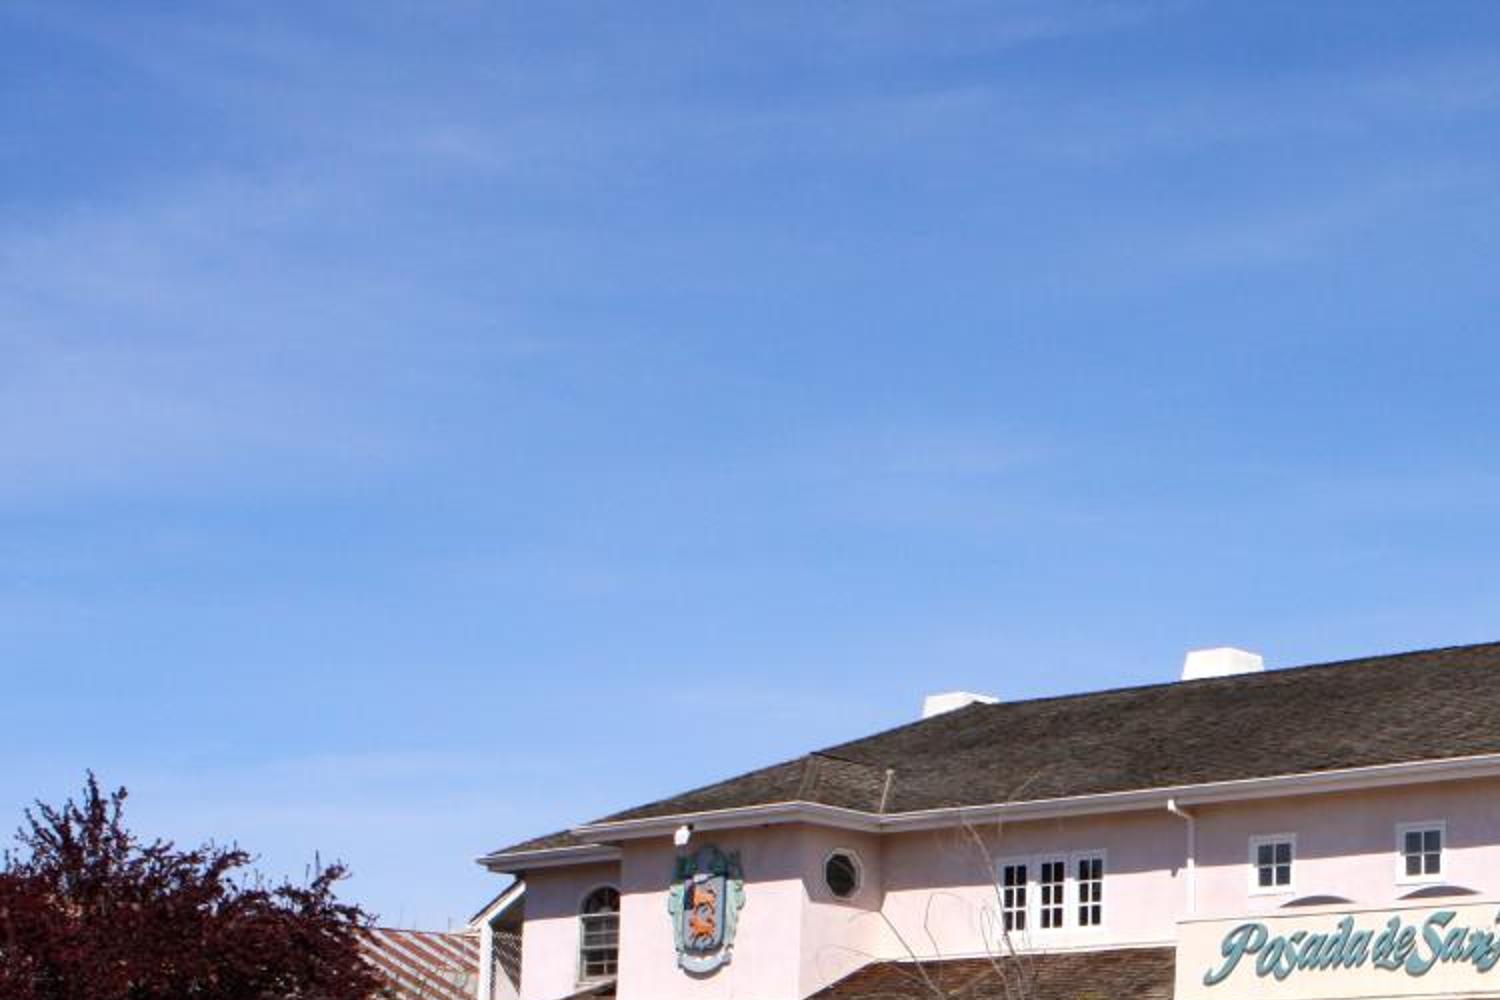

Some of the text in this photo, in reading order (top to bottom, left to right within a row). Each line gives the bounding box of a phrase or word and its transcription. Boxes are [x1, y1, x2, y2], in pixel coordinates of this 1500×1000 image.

[1203, 916, 1375, 986] Posada
[1372, 915, 1418, 973] de
[1405, 911, 1497, 978] San
